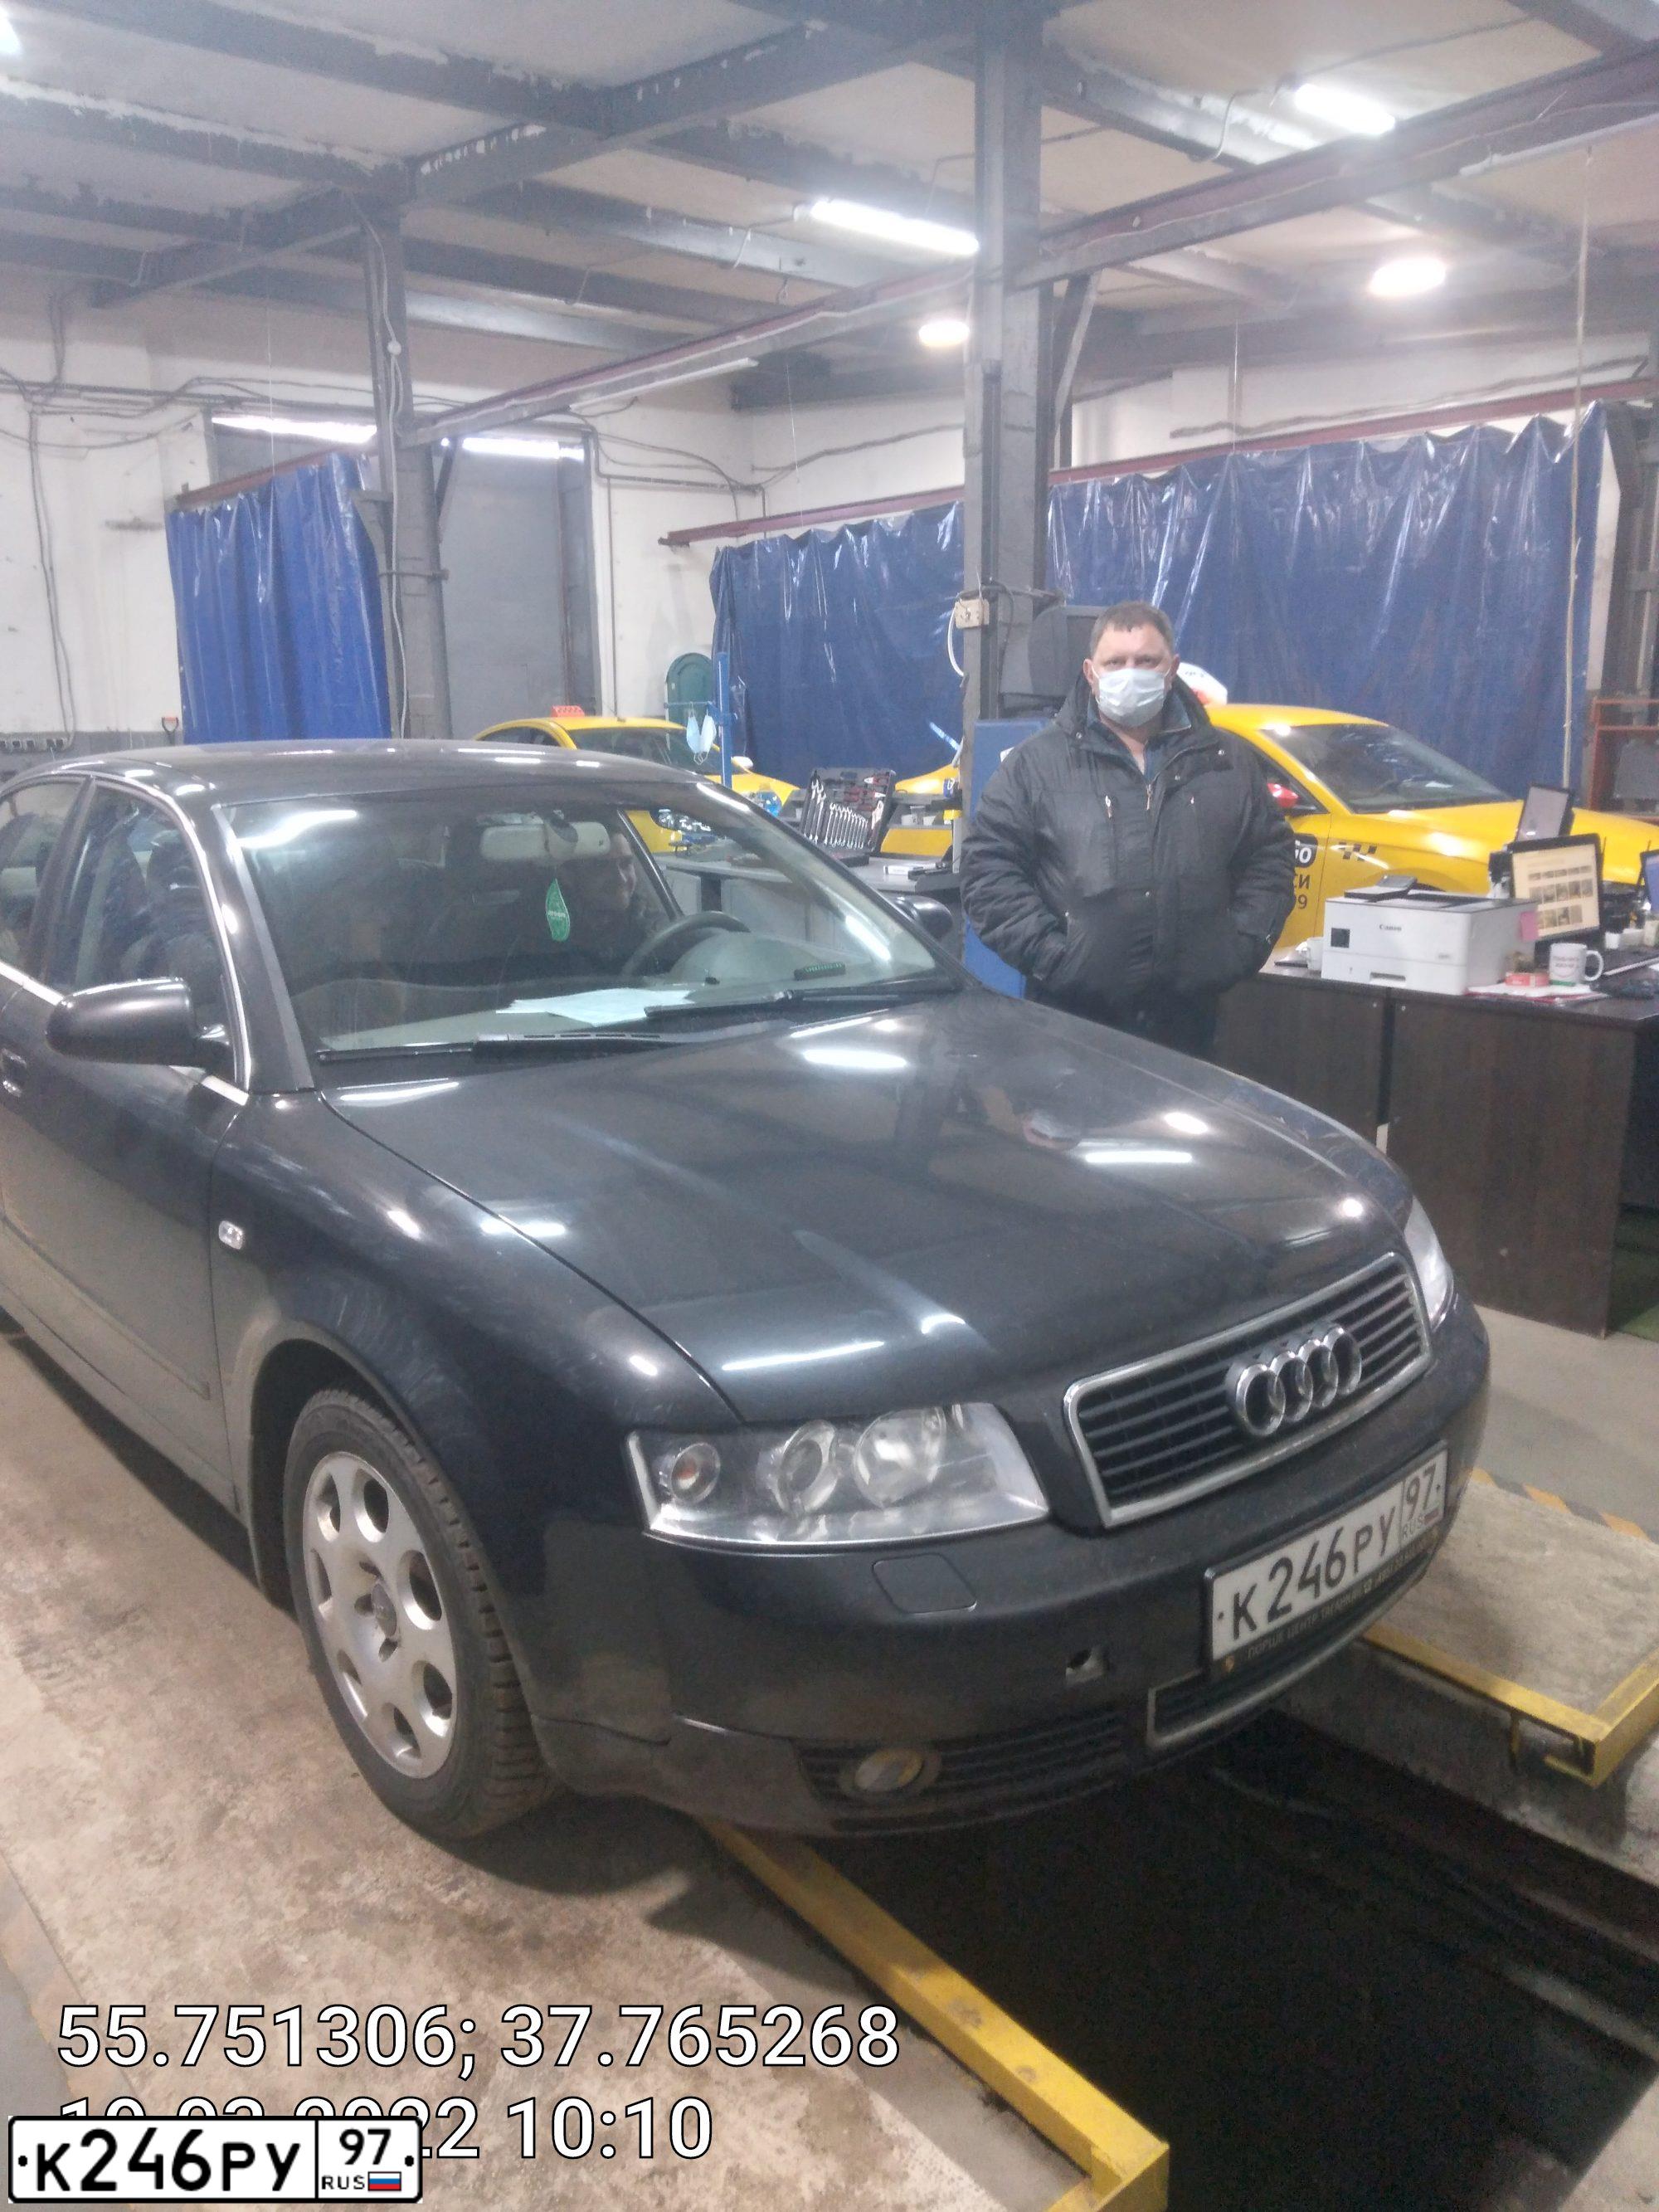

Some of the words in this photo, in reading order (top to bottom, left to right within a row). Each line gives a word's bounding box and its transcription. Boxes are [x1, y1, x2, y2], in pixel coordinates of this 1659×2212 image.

[1379, 923, 1402, 932] Canon
[1405, 1463, 1437, 1521] 97
[1232, 1505, 1396, 1640] К246РУ
